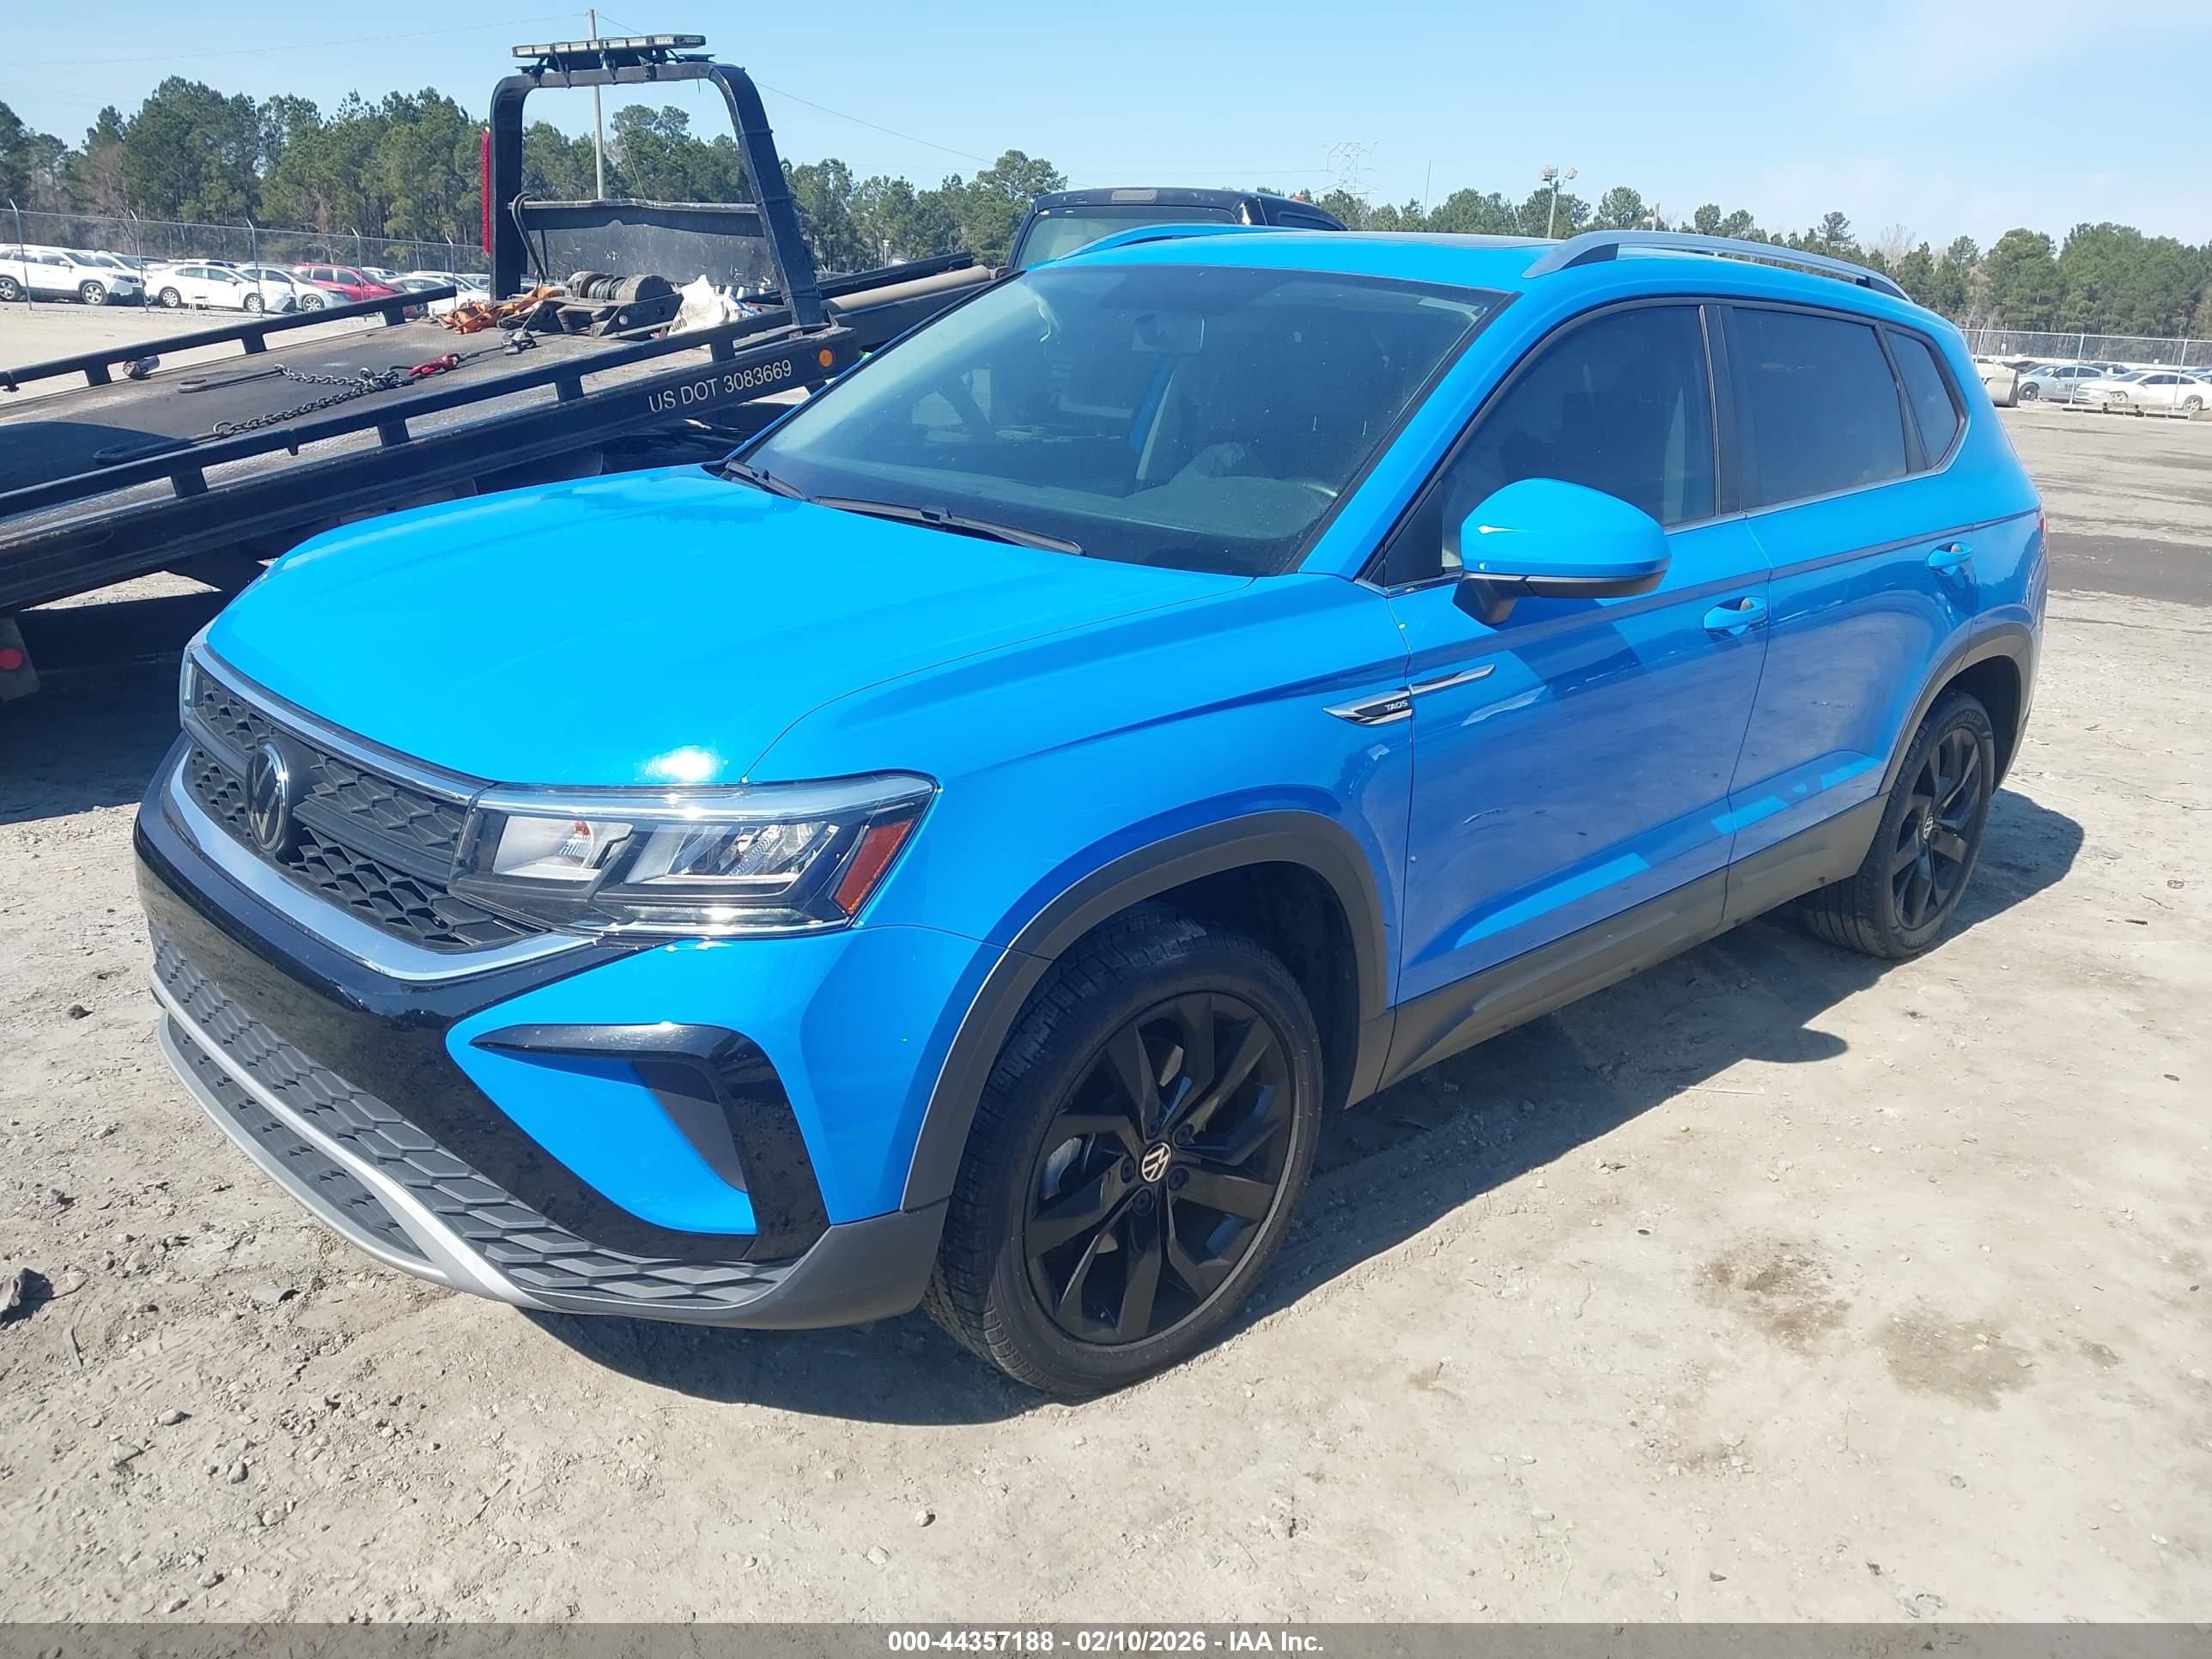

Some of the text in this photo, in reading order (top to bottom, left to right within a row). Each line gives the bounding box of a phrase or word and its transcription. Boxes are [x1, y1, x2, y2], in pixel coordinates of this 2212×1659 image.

[648, 359, 792, 412] US DOT 3083669
[1384, 699, 1409, 712] TAOS
